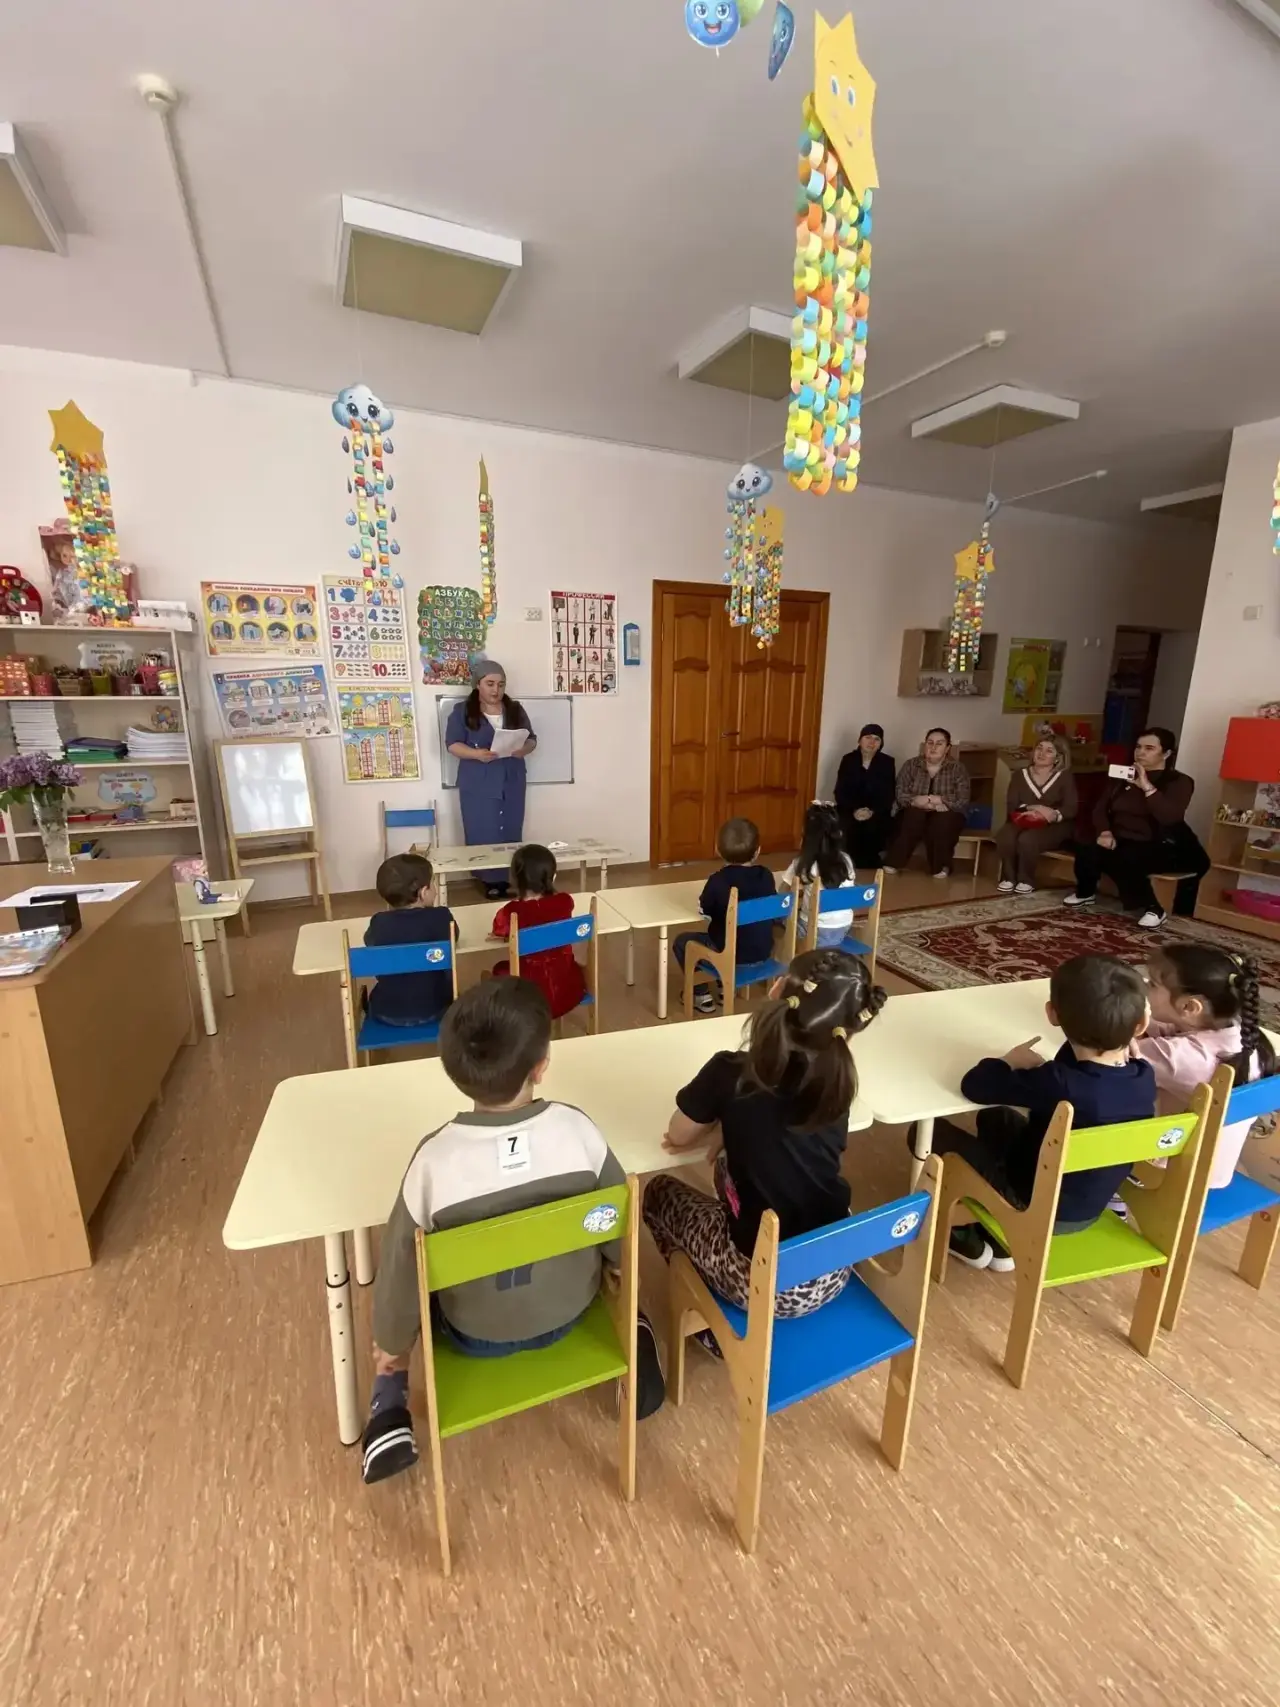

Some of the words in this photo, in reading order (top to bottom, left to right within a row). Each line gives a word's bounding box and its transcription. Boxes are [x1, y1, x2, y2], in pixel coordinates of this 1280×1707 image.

[328, 588, 336, 602] 1
[435, 588, 470, 598] АЗБУКА
[330, 606, 340, 621] 3
[368, 608, 378, 622] 4
[332, 625, 342, 640] 5
[370, 627, 380, 641] 6
[333, 644, 343, 658] 7
[336, 663, 346, 677] 9
[372, 663, 388, 677] 10
[507, 1136, 518, 1153] 7
